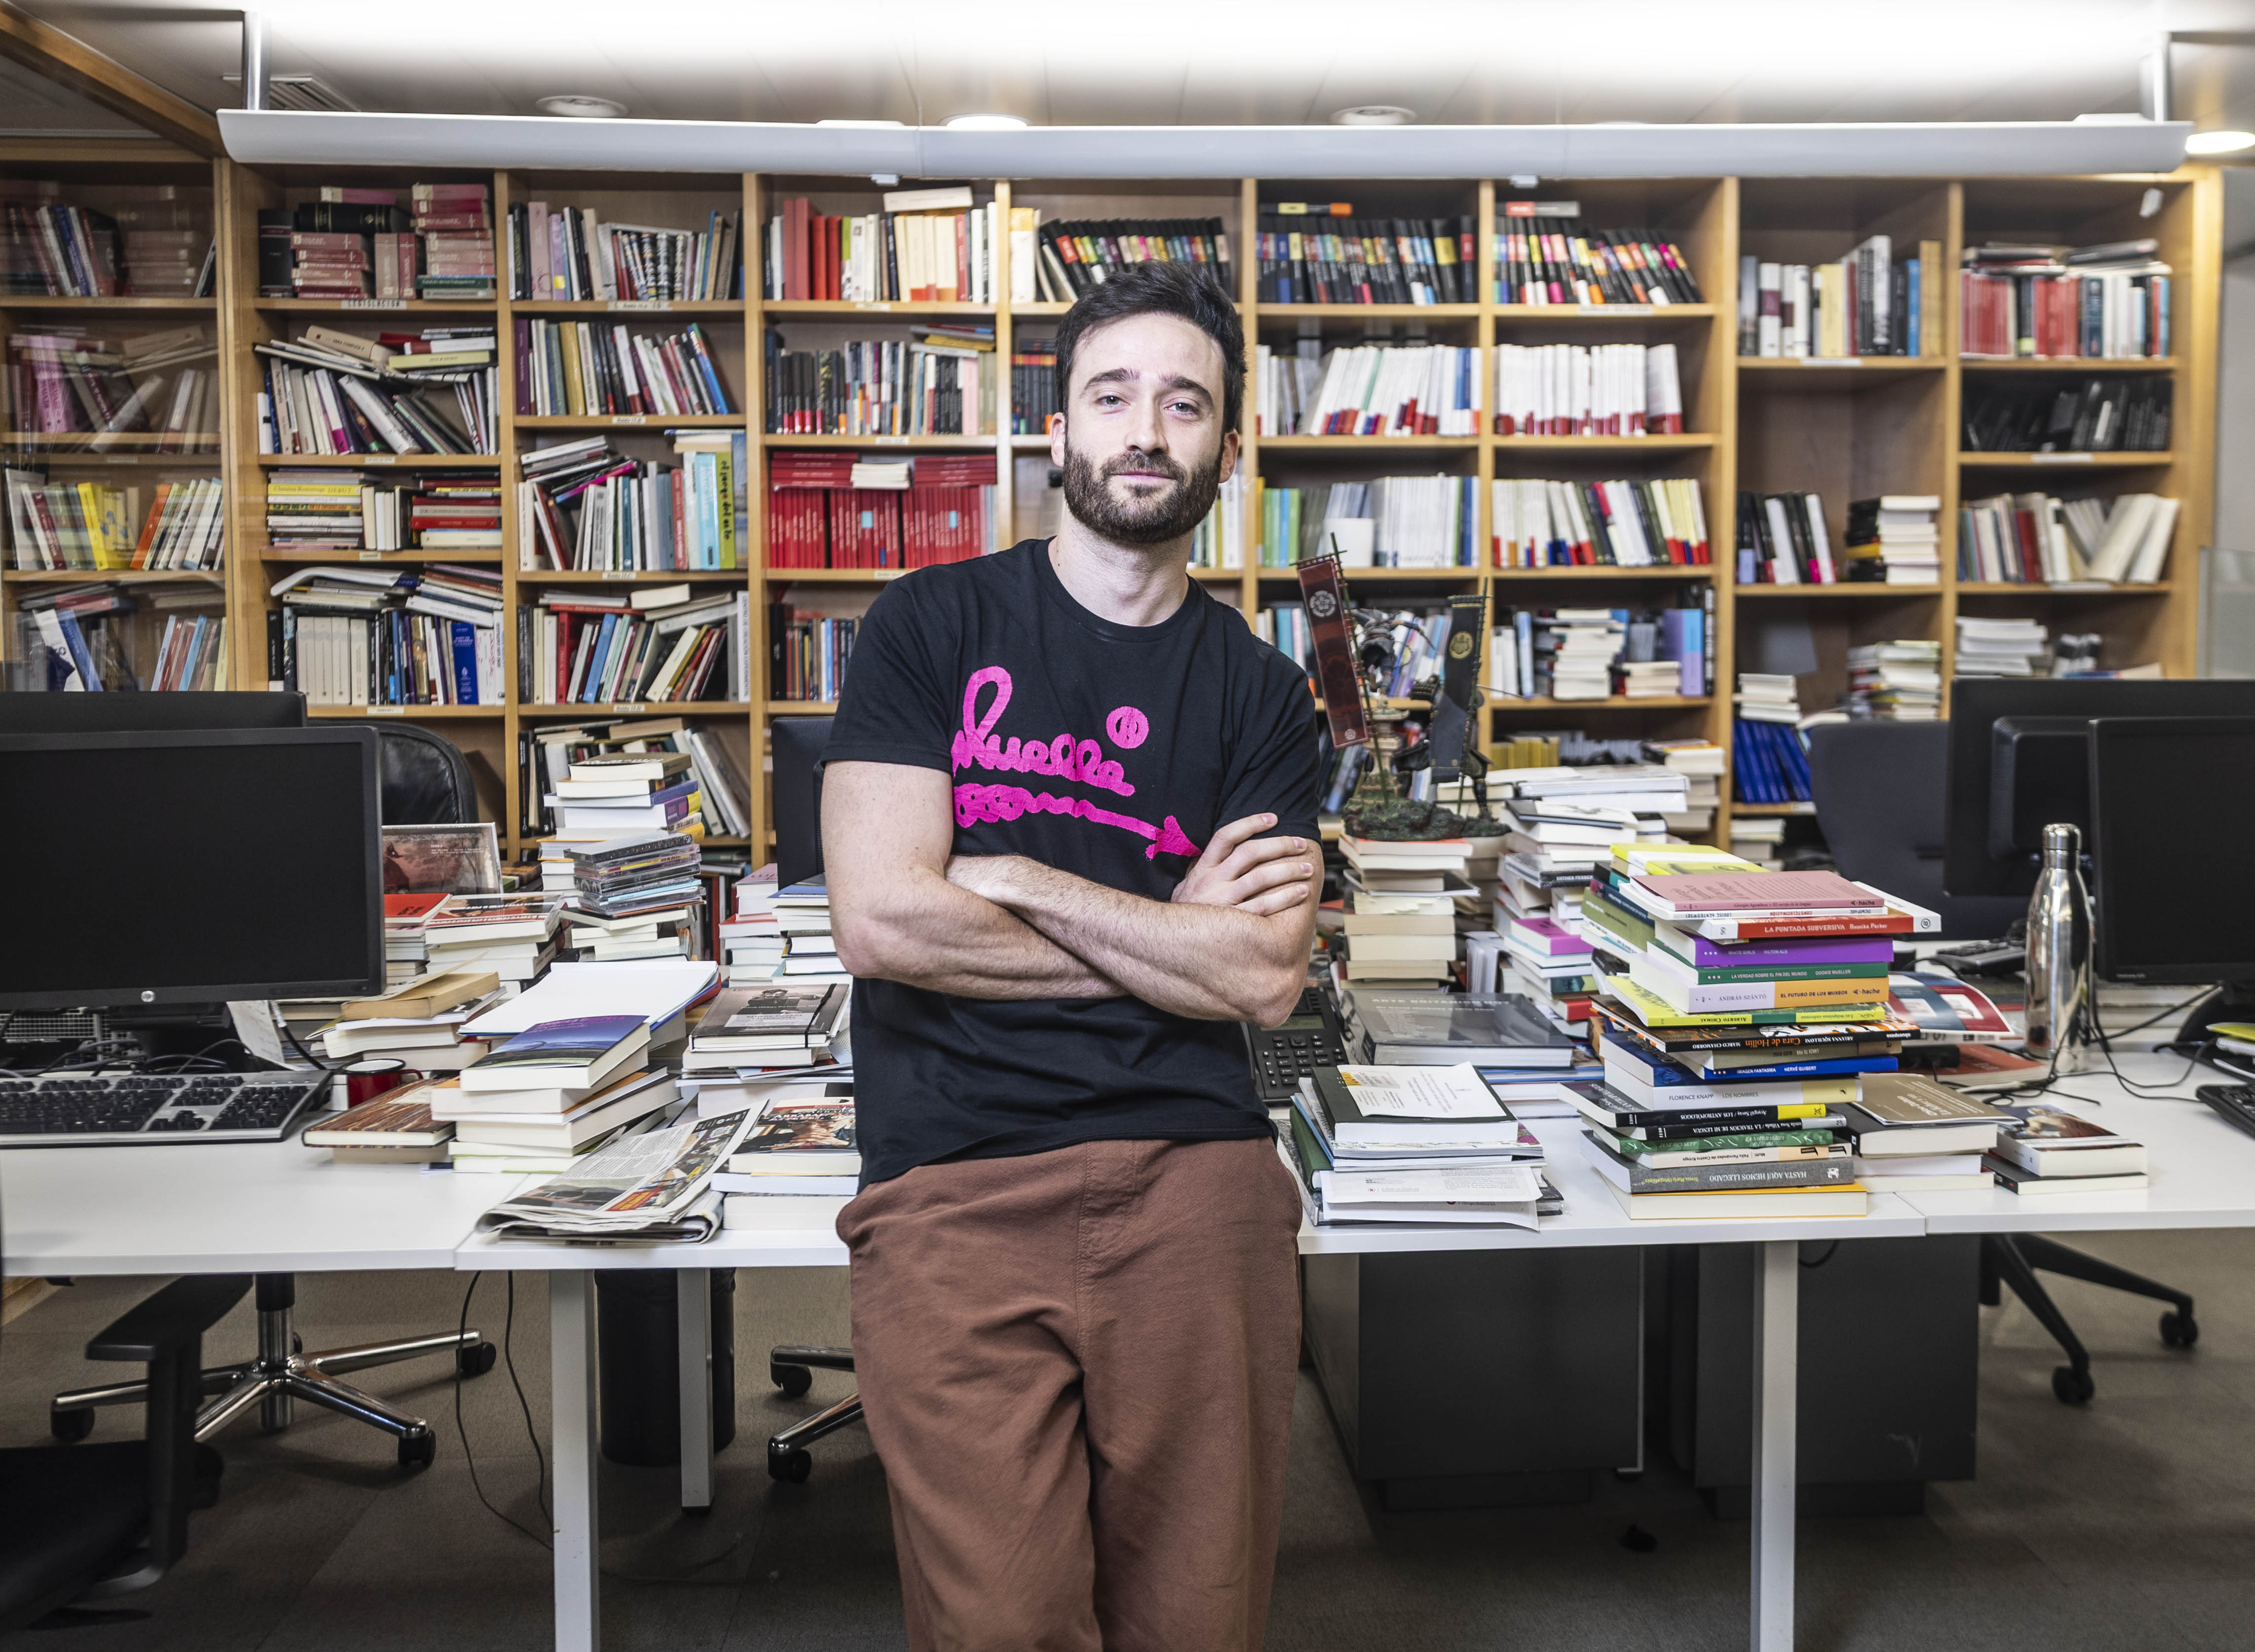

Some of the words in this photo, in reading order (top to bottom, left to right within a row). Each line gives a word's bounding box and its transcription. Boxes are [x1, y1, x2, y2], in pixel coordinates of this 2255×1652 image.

[1745, 1039, 1770, 1048] Hollín
[1771, 1038, 1781, 1046] de
[1783, 1037, 1800, 1046] Cara
[1709, 1174, 1741, 1182] LLEGADO
[1741, 1173, 1766, 1181] HEMOS
[1766, 1172, 1784, 1181] AQUÍ
[1784, 1171, 1807, 1180] HASTA
